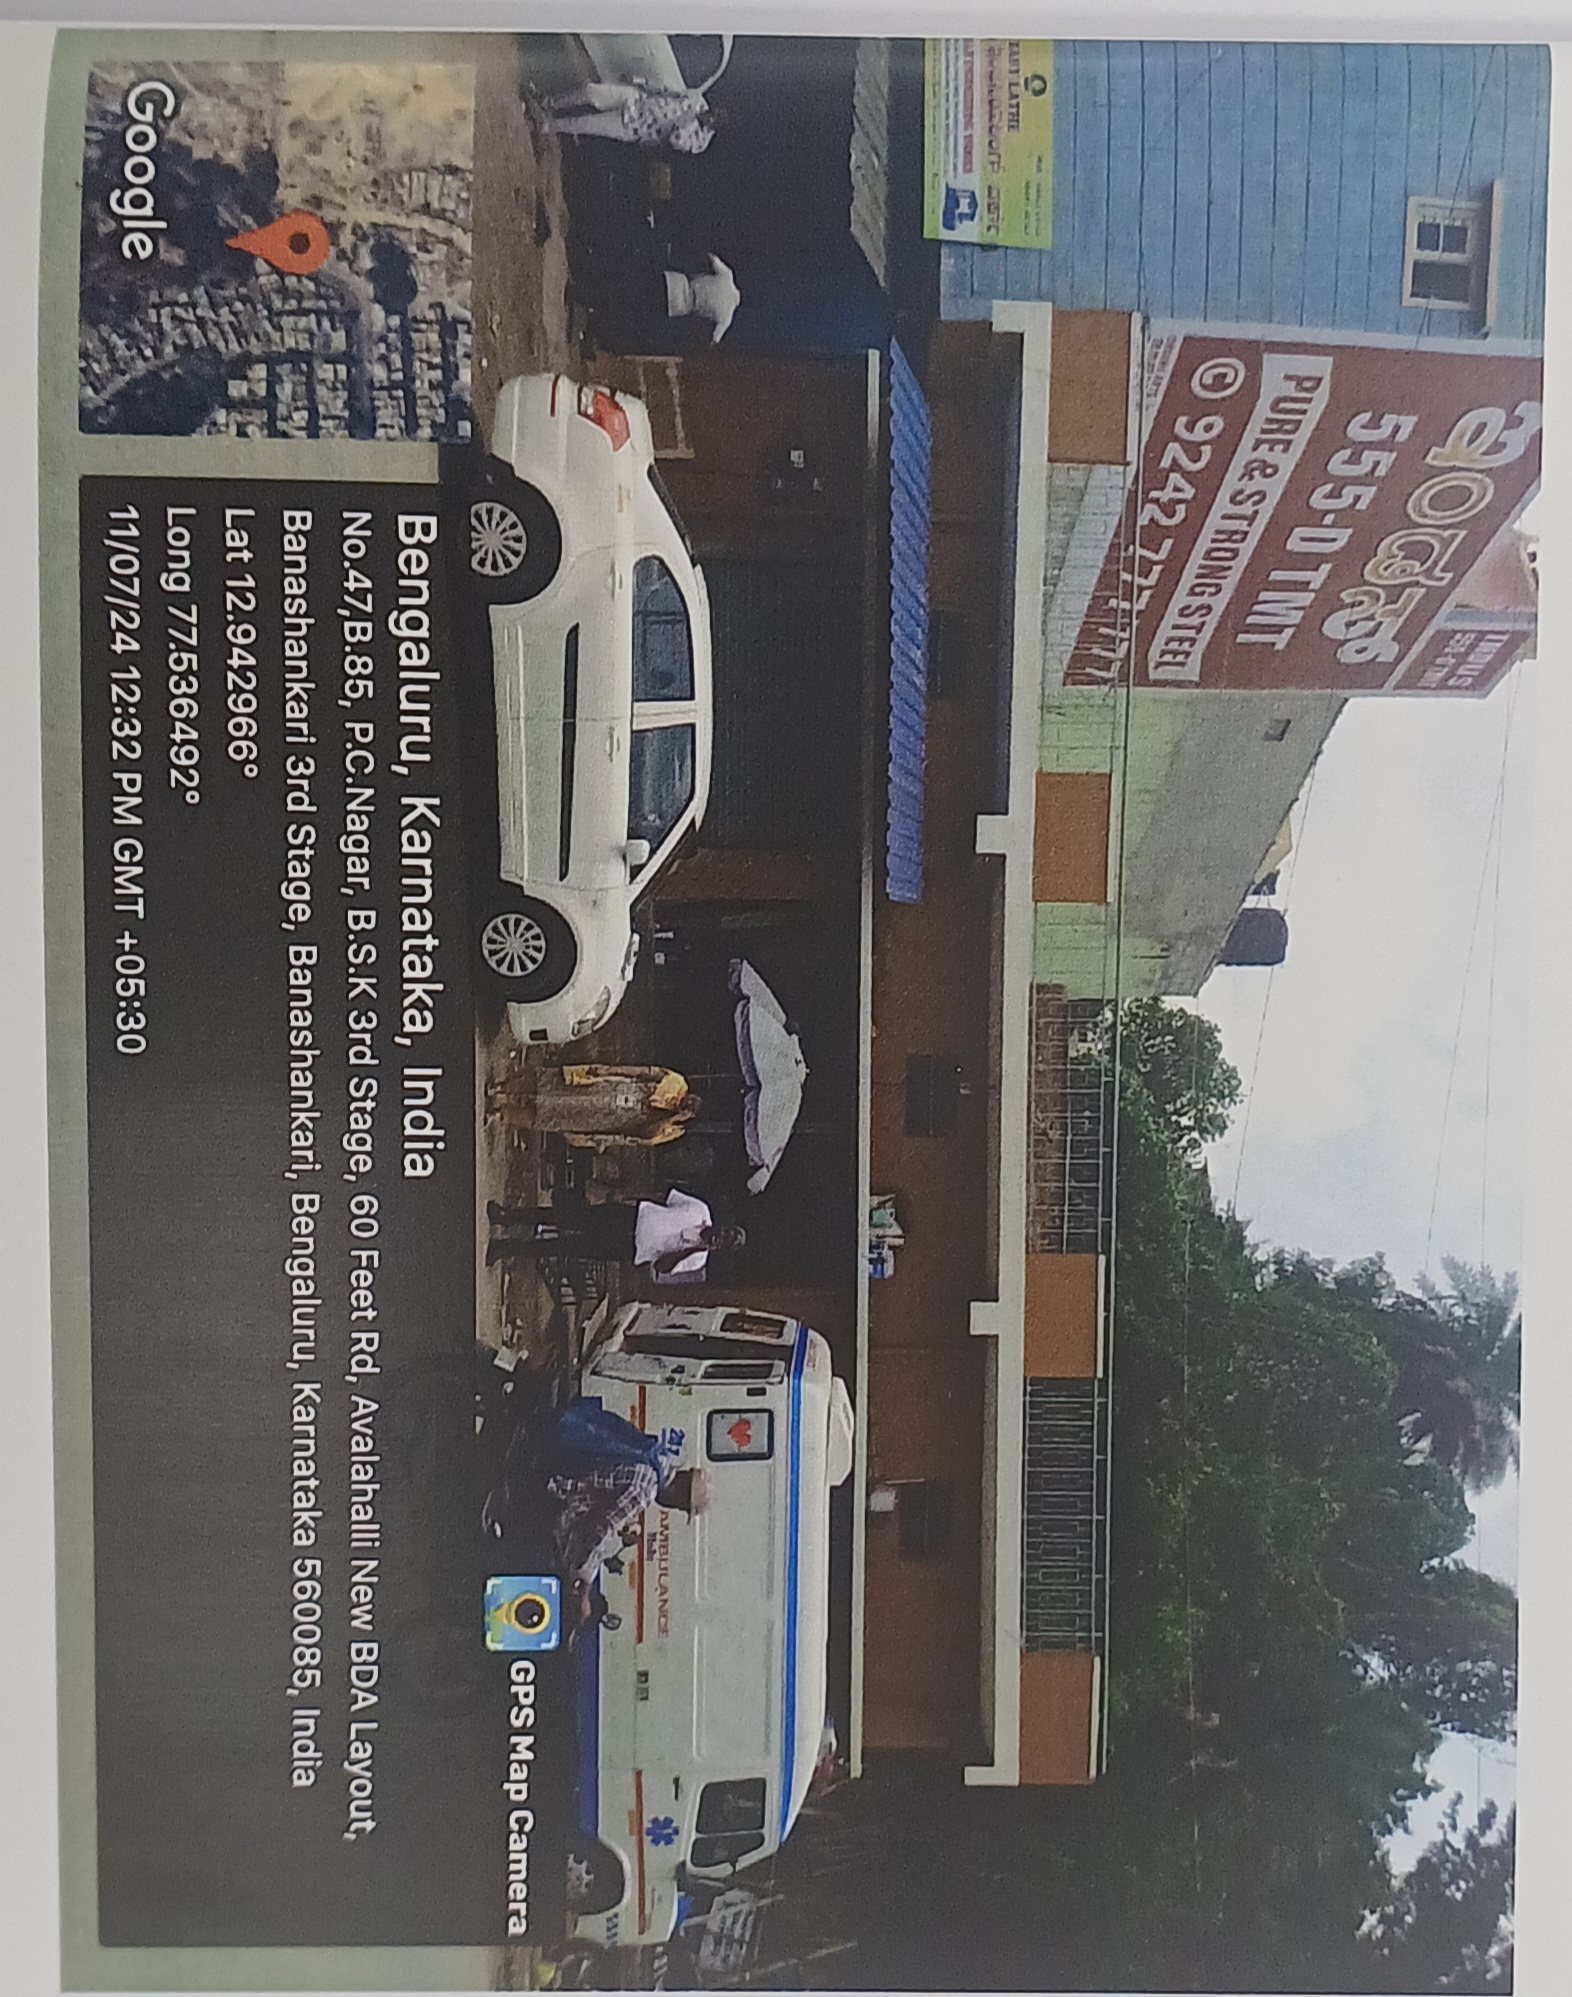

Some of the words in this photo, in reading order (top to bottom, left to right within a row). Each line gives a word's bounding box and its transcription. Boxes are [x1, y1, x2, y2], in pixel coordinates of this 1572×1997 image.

[1007, 82, 1020, 133] LATHE
[1252, 374, 1323, 454] PURE
[1237, 458, 1279, 483] &
[1285, 411, 1419, 552] 555-D
[1186, 488, 1267, 598] STRONG
[1153, 603, 1214, 671] STEEL
[1235, 563, 1332, 650] TMT
[657, 1510, 670, 1639] AMBULANCE
